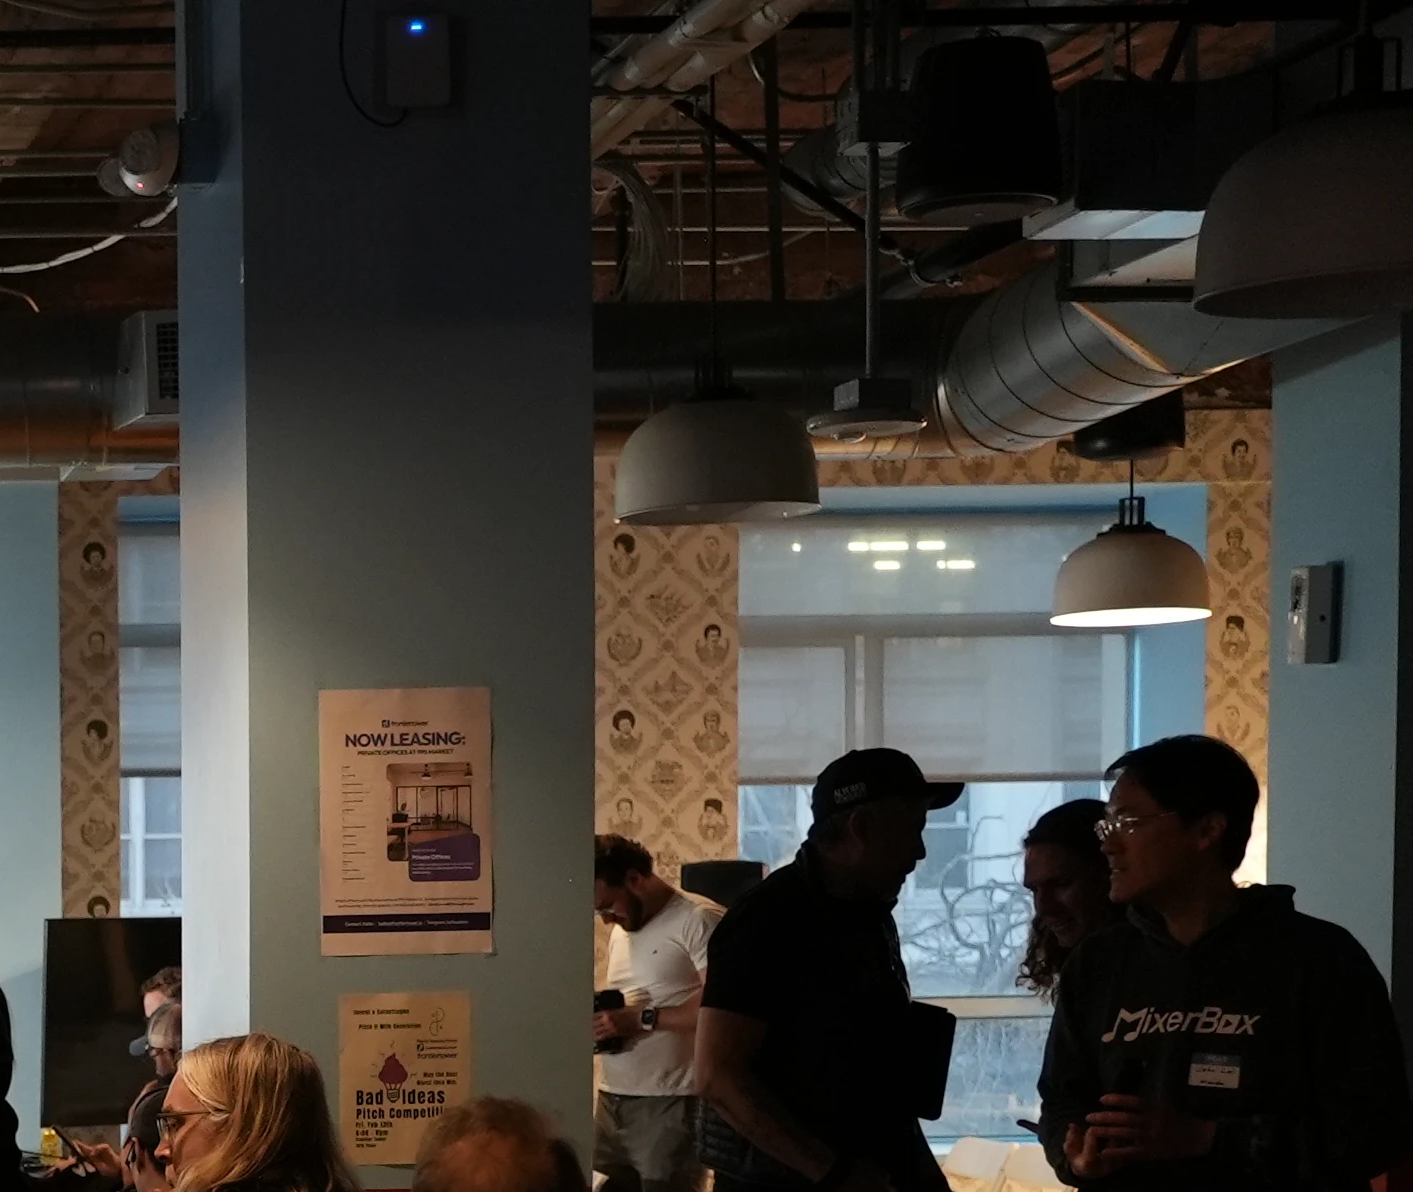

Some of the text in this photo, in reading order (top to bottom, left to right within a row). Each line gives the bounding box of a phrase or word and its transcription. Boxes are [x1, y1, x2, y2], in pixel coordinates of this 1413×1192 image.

[345, 731, 466, 748] NOW LEASING:
[356, 1088, 445, 1106] Bad Ideas
[356, 1106, 443, 1120] Pitch Competiti
